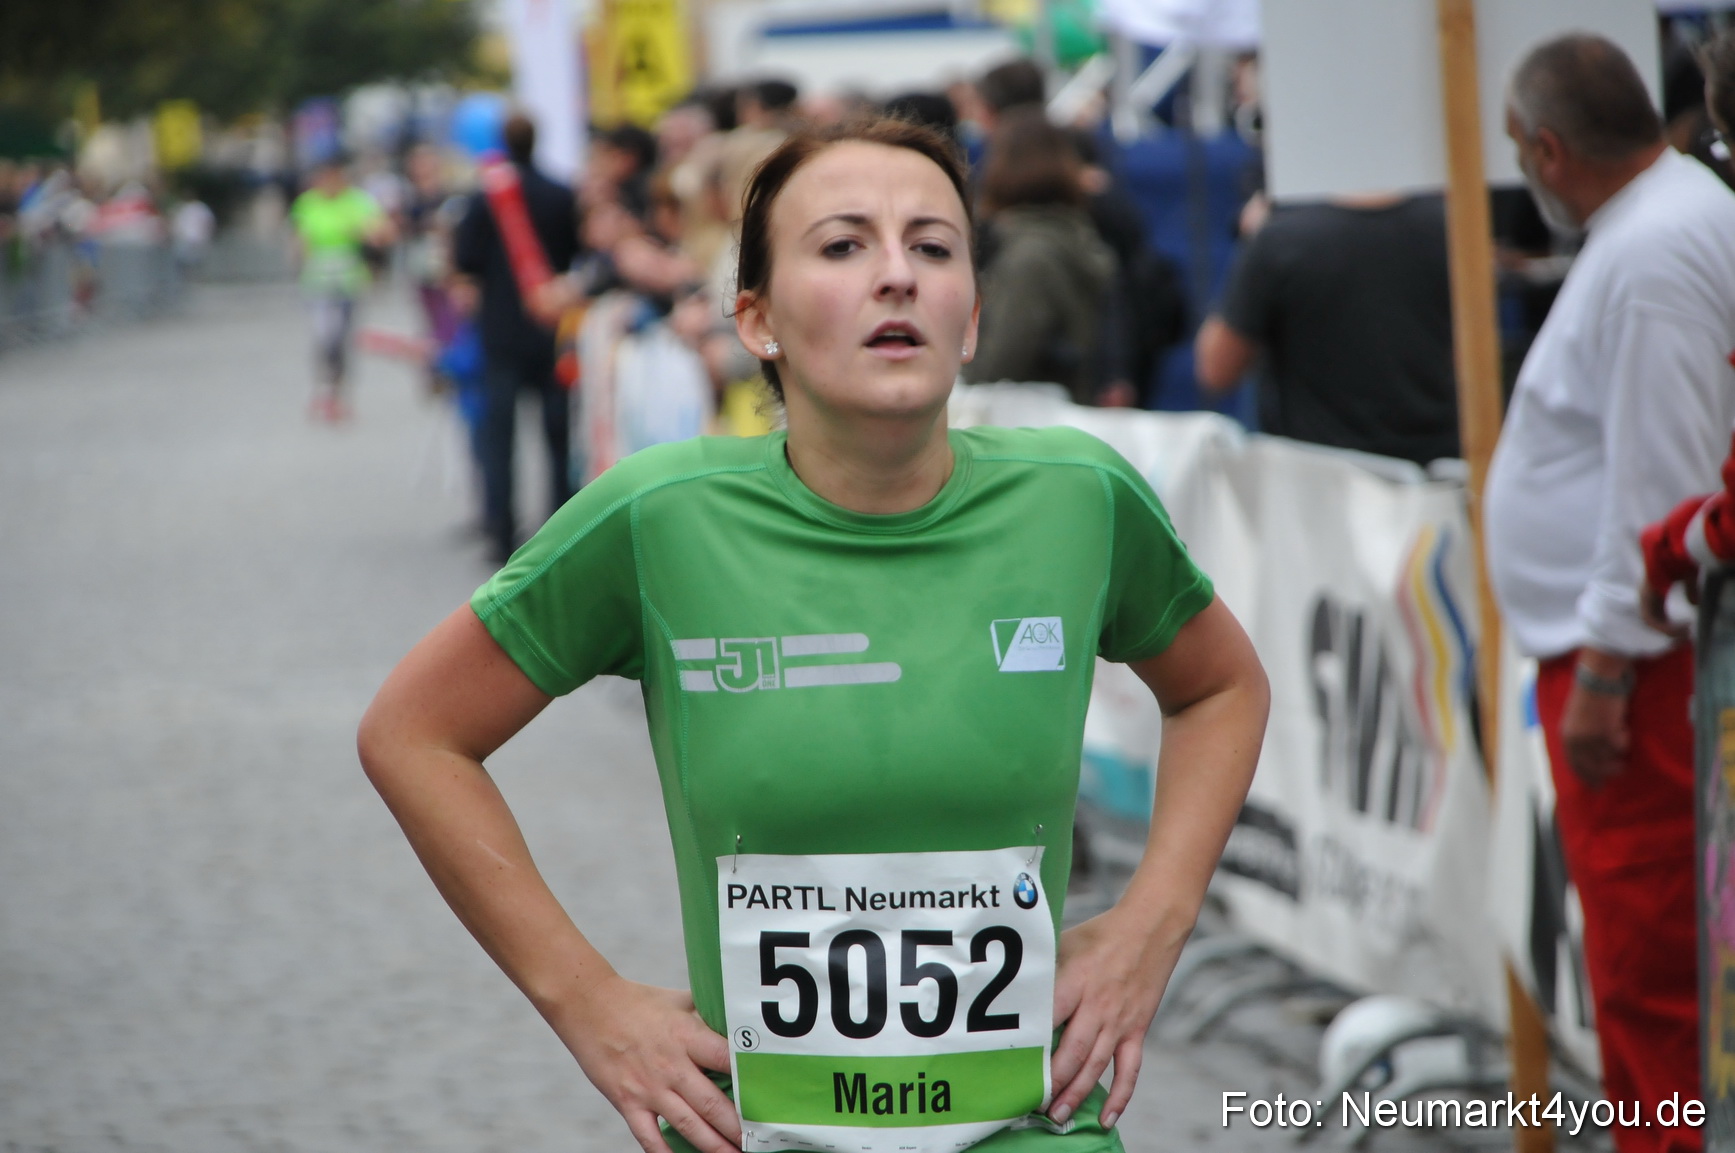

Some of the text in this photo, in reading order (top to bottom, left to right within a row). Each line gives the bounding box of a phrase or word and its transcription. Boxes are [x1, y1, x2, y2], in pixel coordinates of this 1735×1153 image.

[1019, 622, 1060, 645] AOK
[727, 883, 1001, 912] PARTL Neumarkt
[759, 925, 1024, 1040] 5052
[741, 1030, 753, 1048] S
[832, 1072, 951, 1116] Maria
